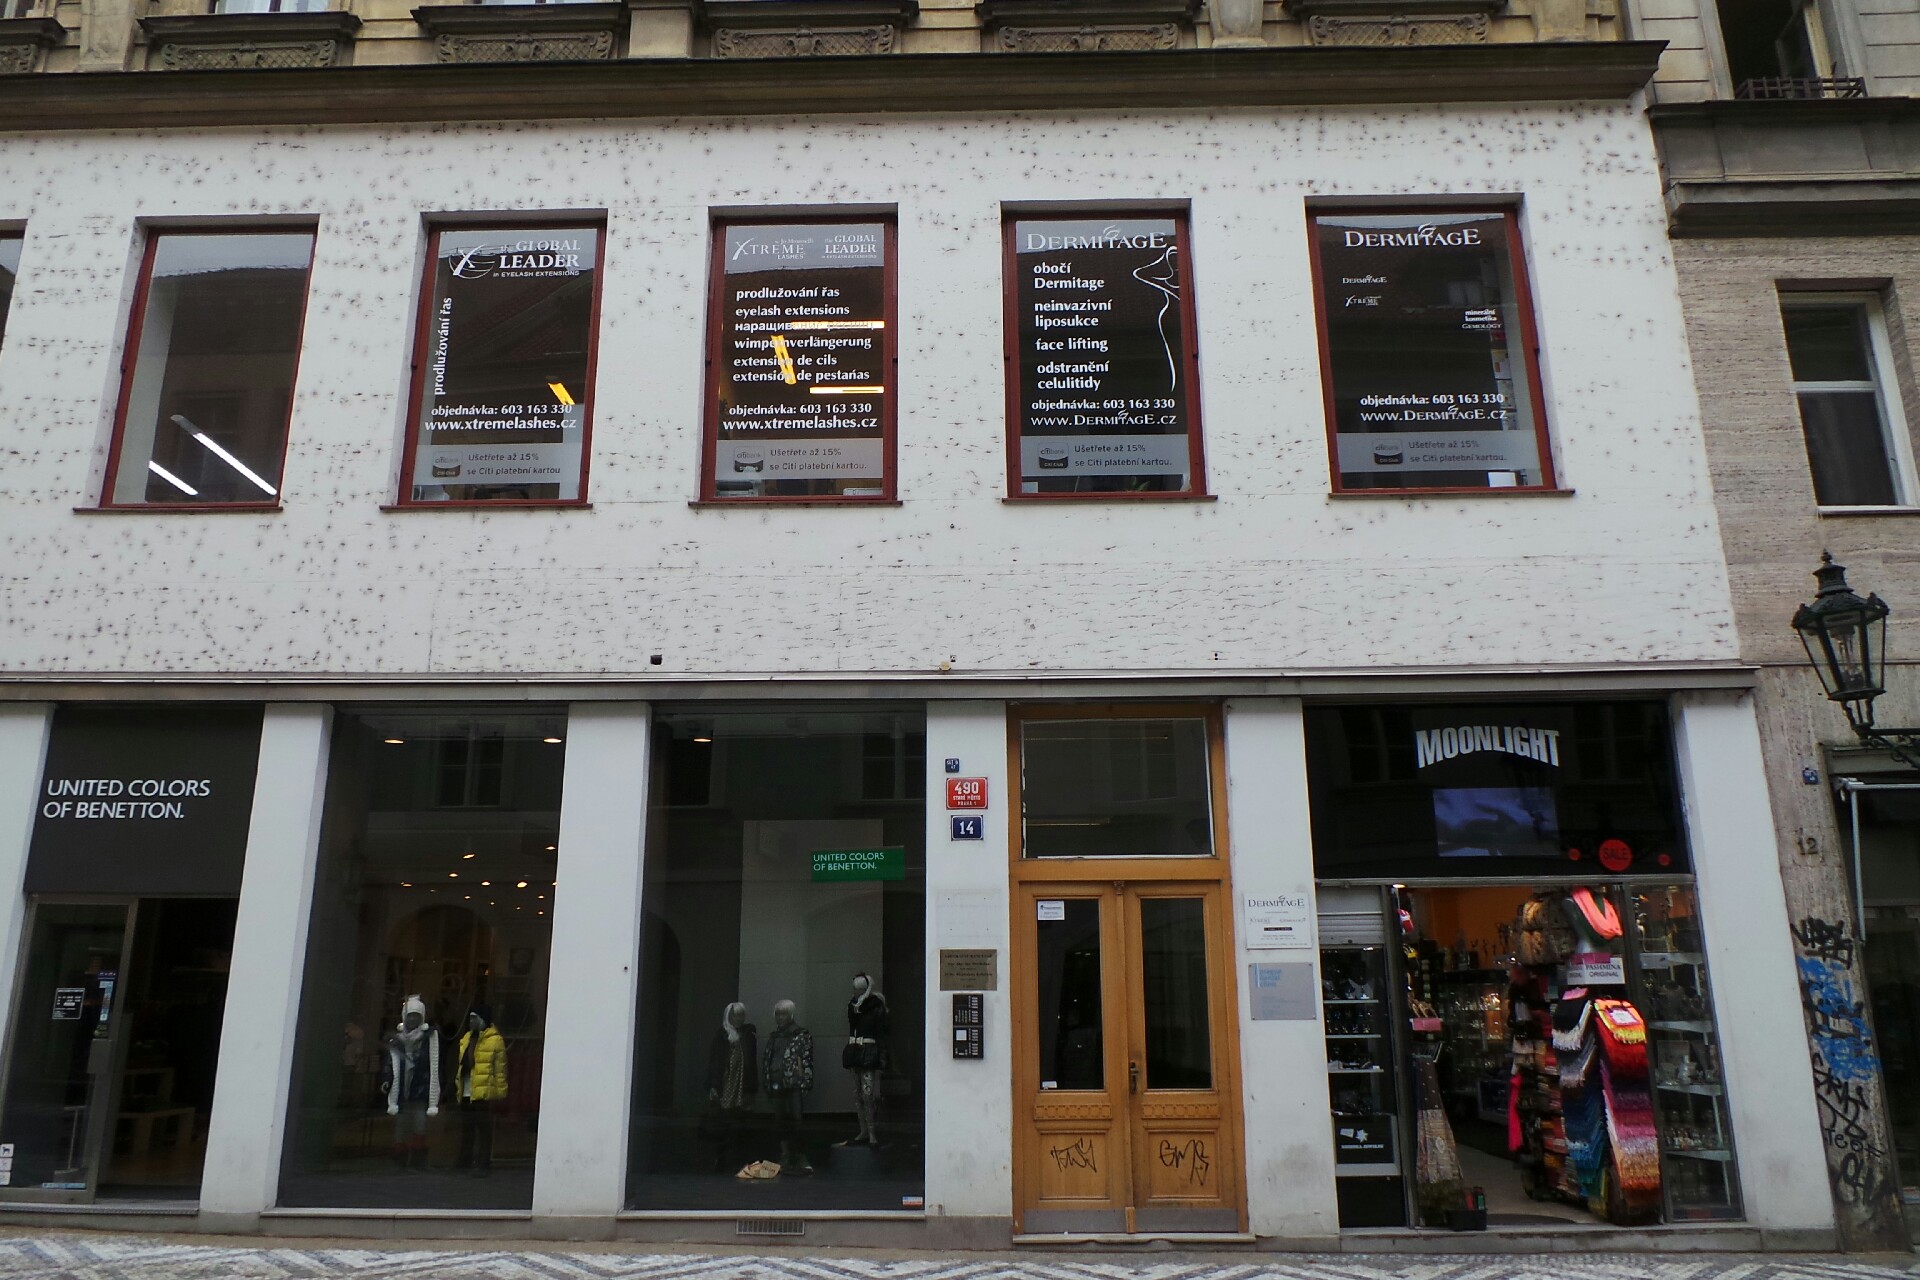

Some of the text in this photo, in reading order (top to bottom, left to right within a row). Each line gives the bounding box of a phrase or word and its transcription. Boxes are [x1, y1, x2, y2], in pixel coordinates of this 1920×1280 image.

[834, 235, 876, 243] GLOBAL
[1027, 231, 1168, 249] DERMITAGE
[1344, 228, 1481, 247] DERMITAGE
[516, 239, 580, 251] GLOBAL
[732, 238, 805, 260] XTREME
[825, 244, 877, 253] LEADER
[499, 254, 580, 268] LEADER
[1034, 262, 1072, 274] obočí
[1034, 277, 1105, 291] Dermitage
[1342, 275, 1387, 284] DERMITAGE
[736, 287, 840, 301] prodlužování řas
[735, 304, 850, 319] eyelash extensions
[1034, 299, 1113, 311] neinvazivní
[1035, 315, 1099, 330] liposukce
[433, 297, 452, 395] prodlužování řas
[1035, 338, 1109, 352] face lifting
[797, 355, 813, 365] de
[816, 354, 837, 365] cils
[1037, 361, 1110, 374] odstranění
[797, 370, 812, 380] de
[1038, 376, 1101, 391] celulitidy
[1031, 399, 1175, 412] objednávka: 603 163 330
[1360, 394, 1504, 408] objednávka: 603 163 330
[431, 404, 572, 417] objednávka: 603 163 330
[729, 403, 872, 417] objednávka: 603 163 330
[425, 416, 576, 431] www.xtremelashes.cz
[723, 416, 877, 430] www.xtremelashes.cz
[1074, 445, 1112, 453] Ušetřete
[1408, 441, 1445, 449] Ušetřete
[1461, 440, 1480, 448] 15%
[468, 453, 539, 461] Ušetřete až 15%
[822, 448, 842, 456] 15%
[1440, 454, 1475, 463] platební
[799, 462, 834, 471] platební
[1105, 458, 1140, 468] platební
[479, 467, 494, 475] Citi
[496, 467, 531, 475] platební
[1416, 725, 1559, 768] MOONLIGHT
[48, 779, 211, 796] UNITED COLORS
[955, 782, 979, 794] 490
[43, 801, 185, 818] OF BENETTON.
[960, 821, 973, 834] 14
[1798, 828, 1818, 855] 12
[813, 852, 884, 861] UNITED COLORS
[1603, 849, 1628, 860] SALE
[813, 862, 877, 871] OF BENETTON.
[1248, 897, 1304, 907] DERMITAGE
